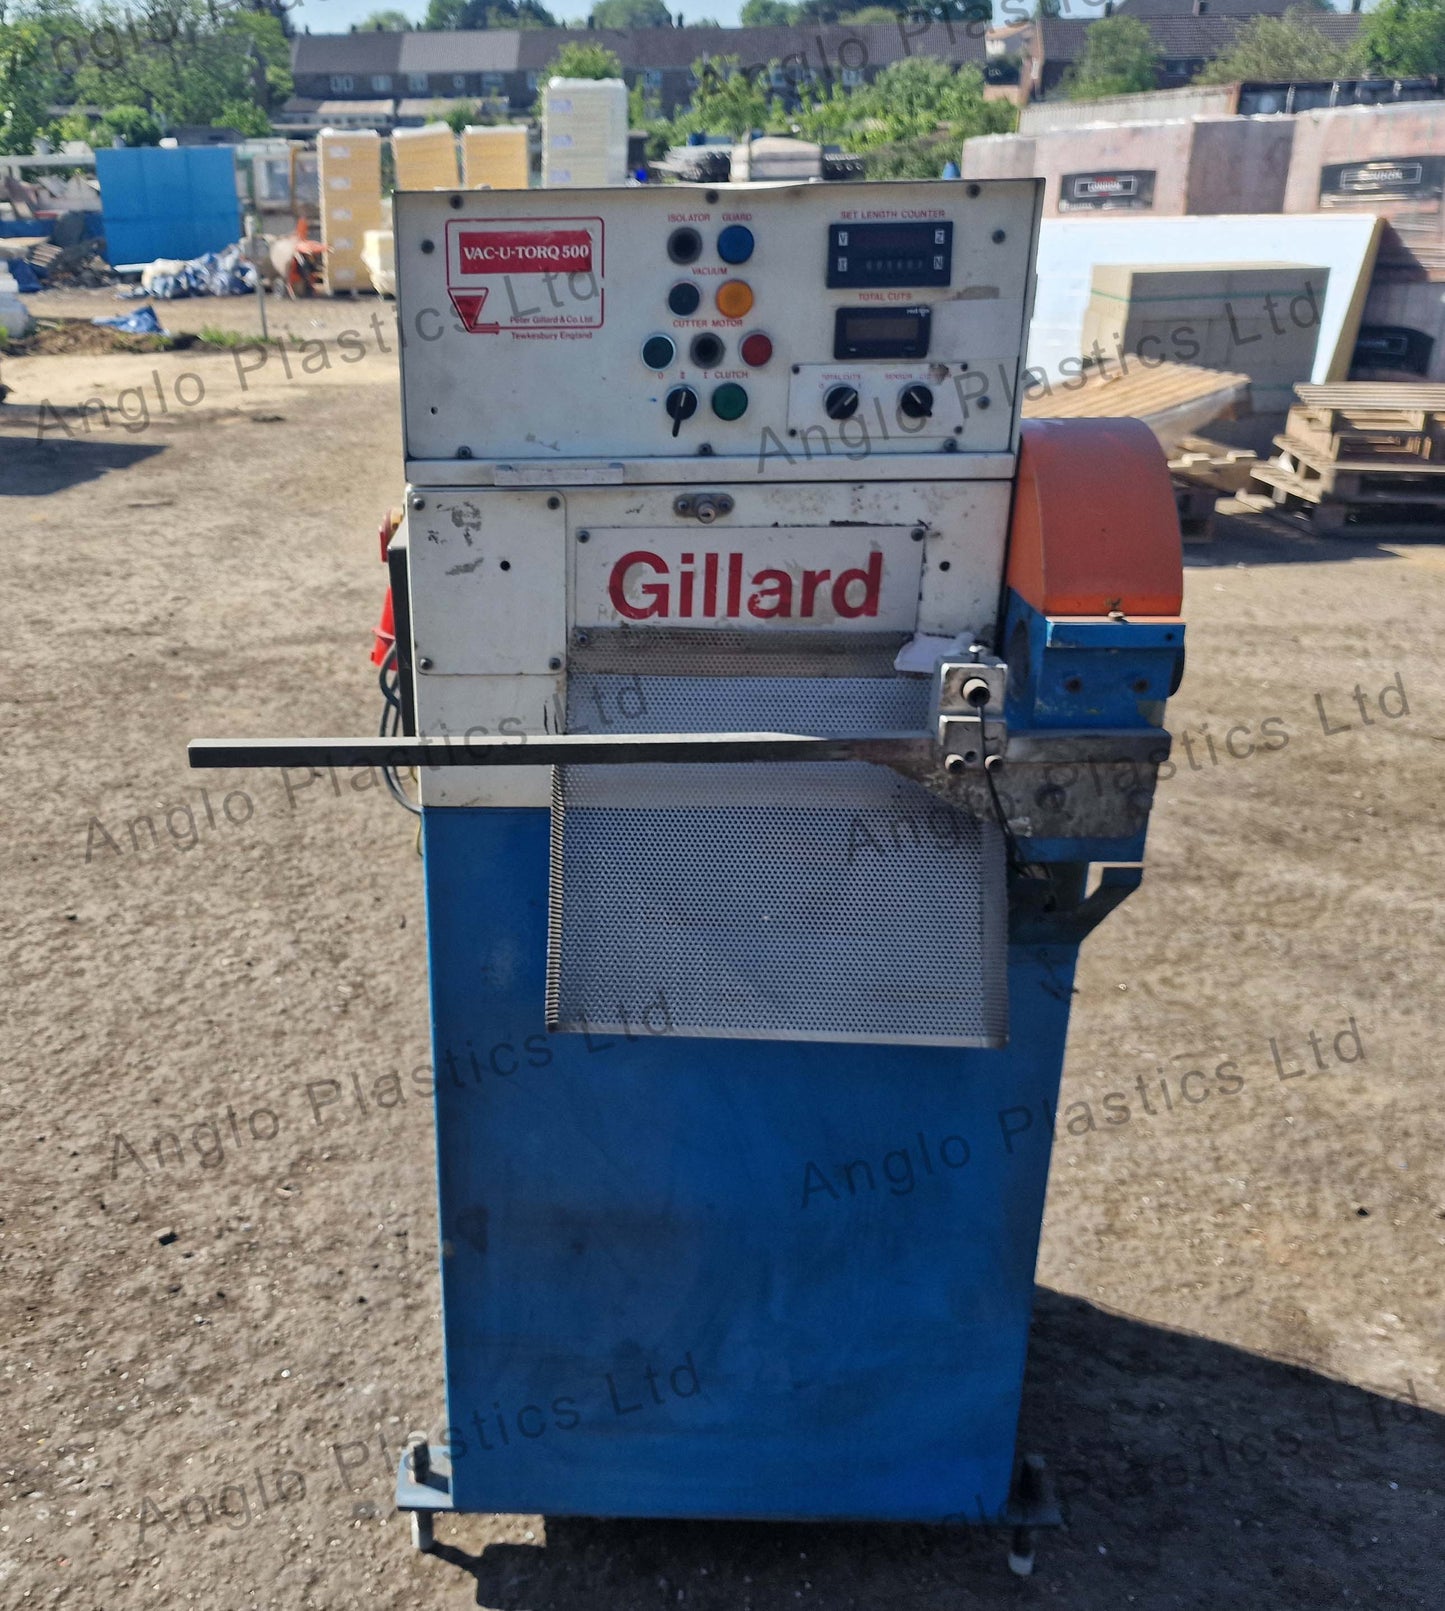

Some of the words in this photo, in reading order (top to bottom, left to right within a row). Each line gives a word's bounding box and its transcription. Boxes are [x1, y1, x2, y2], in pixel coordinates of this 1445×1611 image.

[668, 213, 710, 222] ISOLATOR
[722, 212, 752, 221] GUARD
[841, 211, 858, 220] SET
[861, 210, 898, 218] LENGTH
[901, 210, 946, 218] COUNTER
[463, 245, 560, 261] VAC-U-TORQ
[562, 244, 589, 259] 500
[859, 293, 886, 301] TOTAL
[888, 292, 912, 300] CUTS
[672, 320, 708, 328] CUTTER
[711, 320, 742, 328] MOTOR
[512, 332, 558, 340] Tewkesbury
[560, 331, 592, 340] England
[714, 371, 748, 379] CLUTCH
[609, 550, 883, 620] Gillard
